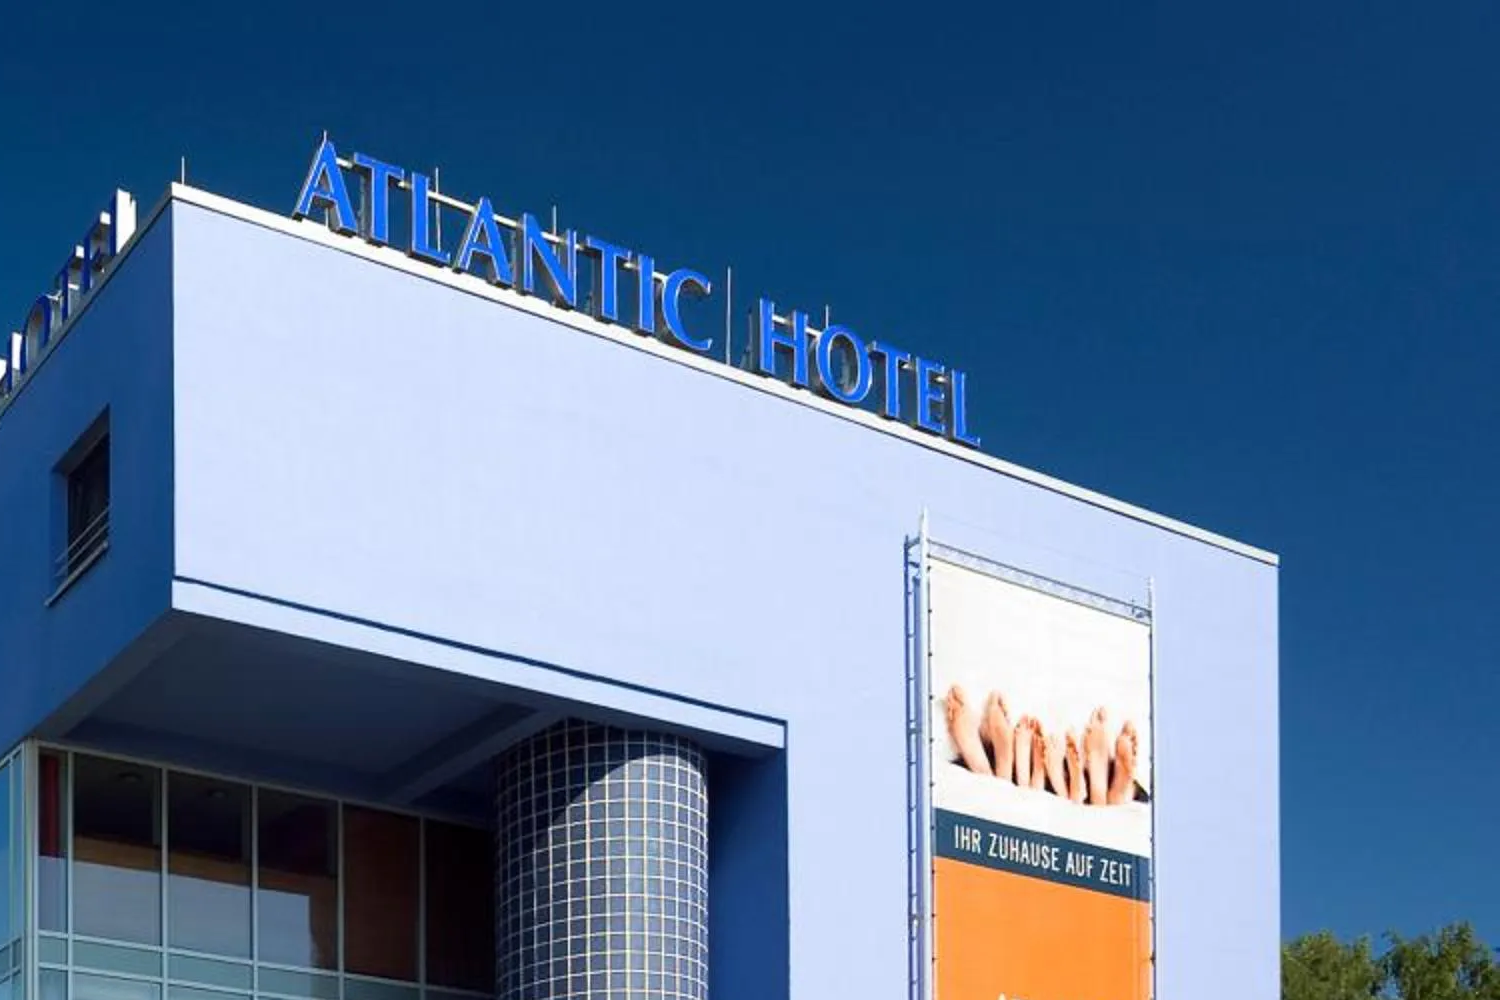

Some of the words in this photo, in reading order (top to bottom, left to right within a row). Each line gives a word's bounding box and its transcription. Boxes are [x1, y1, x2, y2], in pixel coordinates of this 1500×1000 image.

[295, 140, 712, 351] ATLANTIC
[760, 298, 981, 447] HOTEL
[954, 824, 982, 853] IHR
[987, 832, 1061, 871] ZUHAUSE
[1065, 851, 1095, 878] AUF
[1099, 859, 1133, 887] ZEIT
